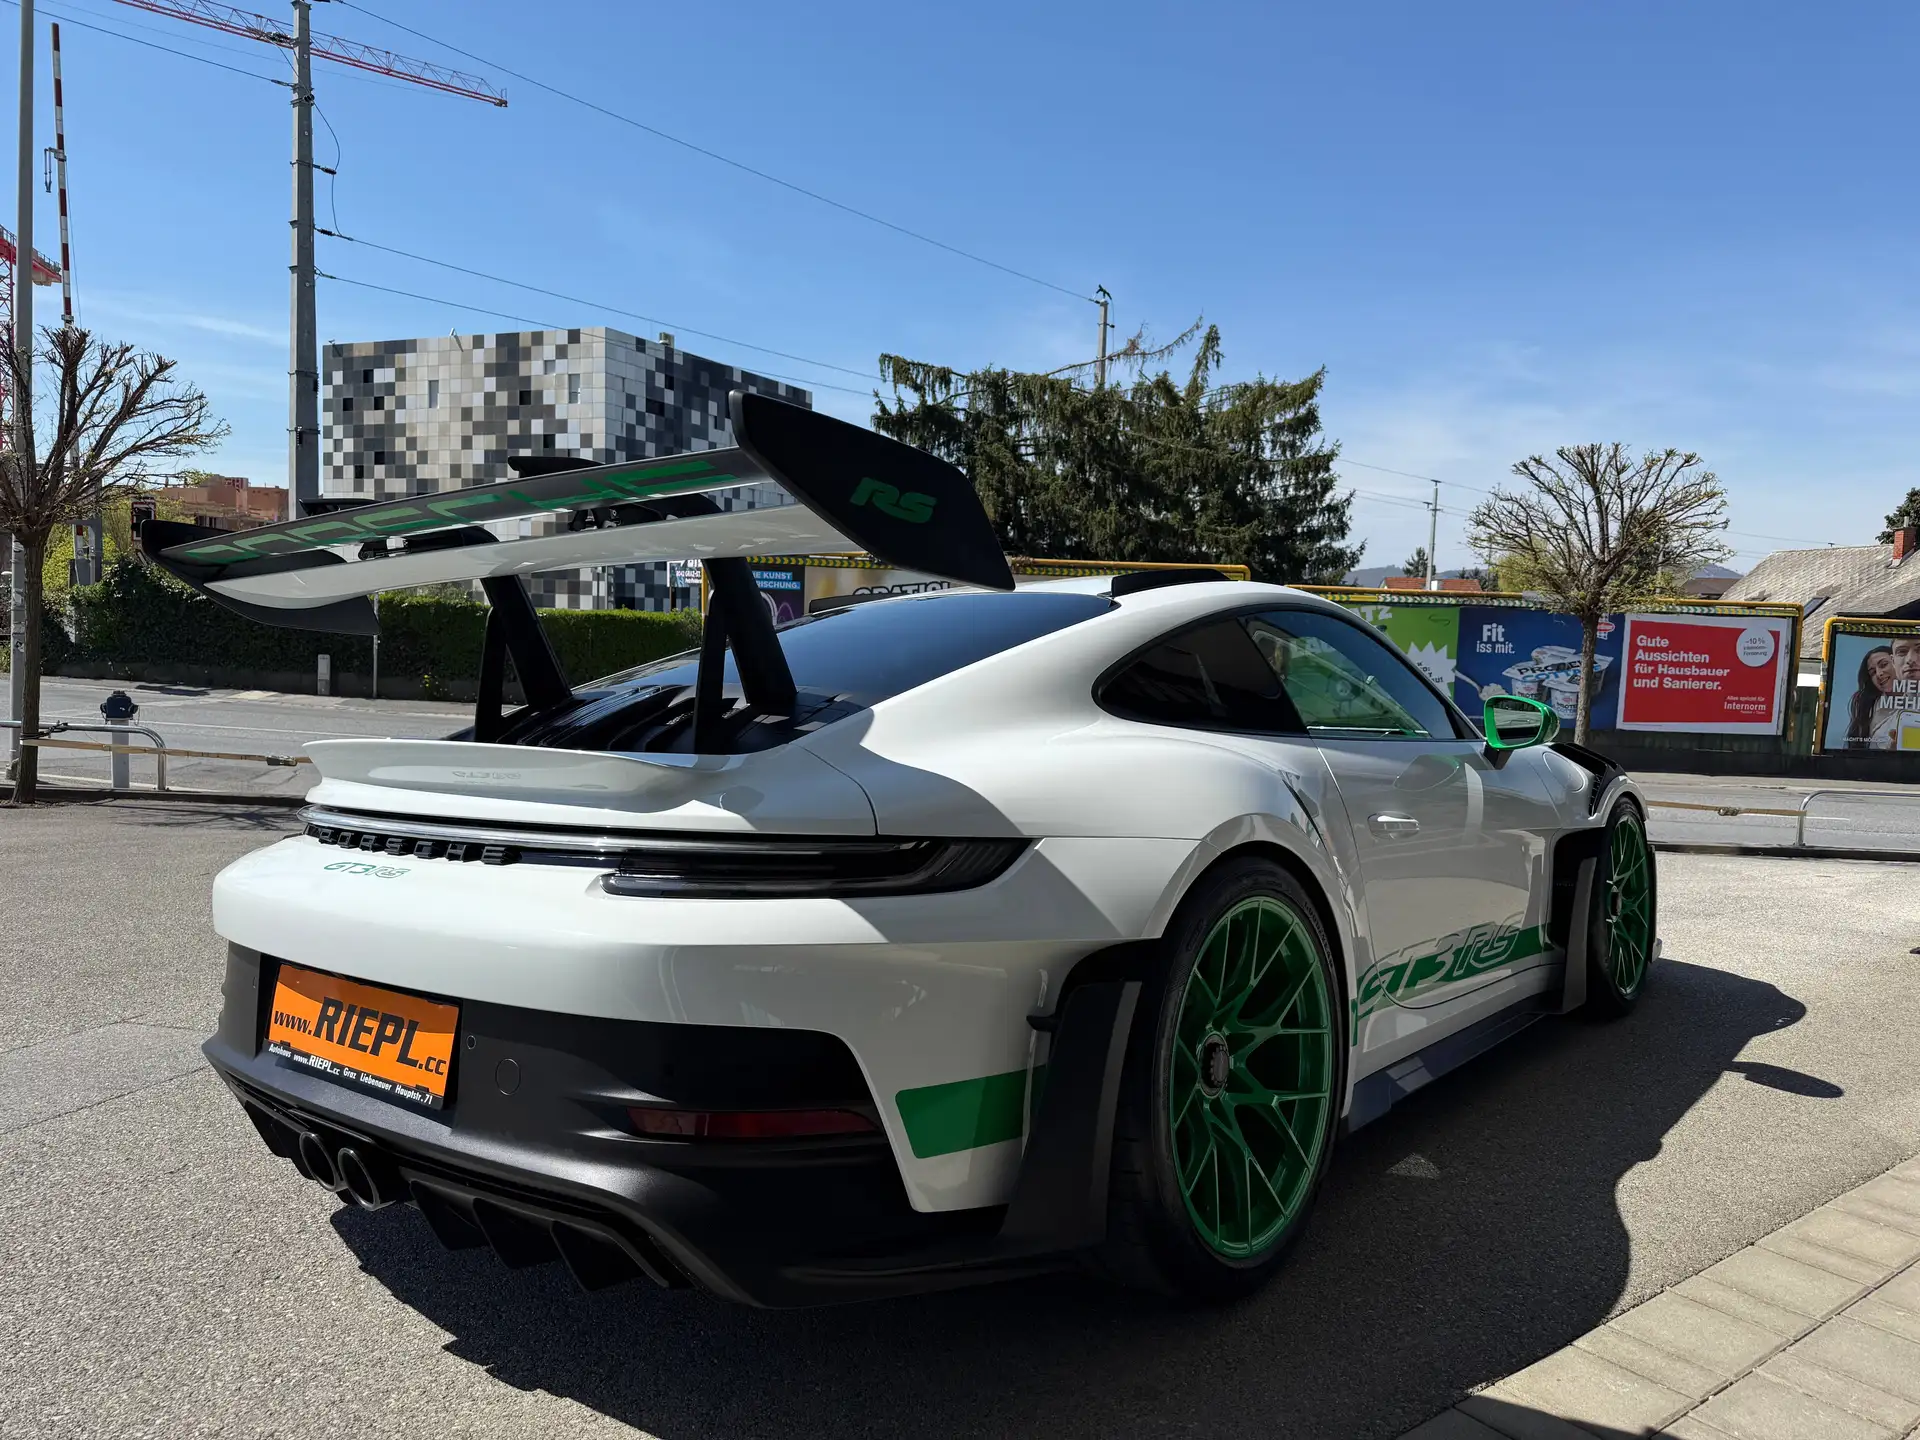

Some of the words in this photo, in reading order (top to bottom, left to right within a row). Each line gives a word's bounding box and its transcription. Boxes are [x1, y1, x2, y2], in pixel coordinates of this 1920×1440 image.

[850, 477, 937, 523] RS
[763, 572, 792, 580] KUNST
[1482, 623, 1505, 642] Fit
[1476, 641, 1492, 653] iss
[1495, 642, 1515, 654] mit.
[1636, 635, 1669, 648] Gute
[1634, 649, 1710, 663] Aussichten
[1634, 663, 1654, 675] für
[1657, 664, 1730, 677] Hausbauer
[1633, 677, 1659, 688] und
[1662, 678, 1722, 690] Sanierer.
[1724, 702, 1767, 711] Internorm
[273, 997, 447, 1076] www.RIEPL.cc
[268, 1043, 292, 1058] Autohaus
[293, 1054, 340, 1076] www.RIEPL.cc
[343, 1067, 357, 1079] Graz
[360, 1072, 392, 1091] Liebenauer
